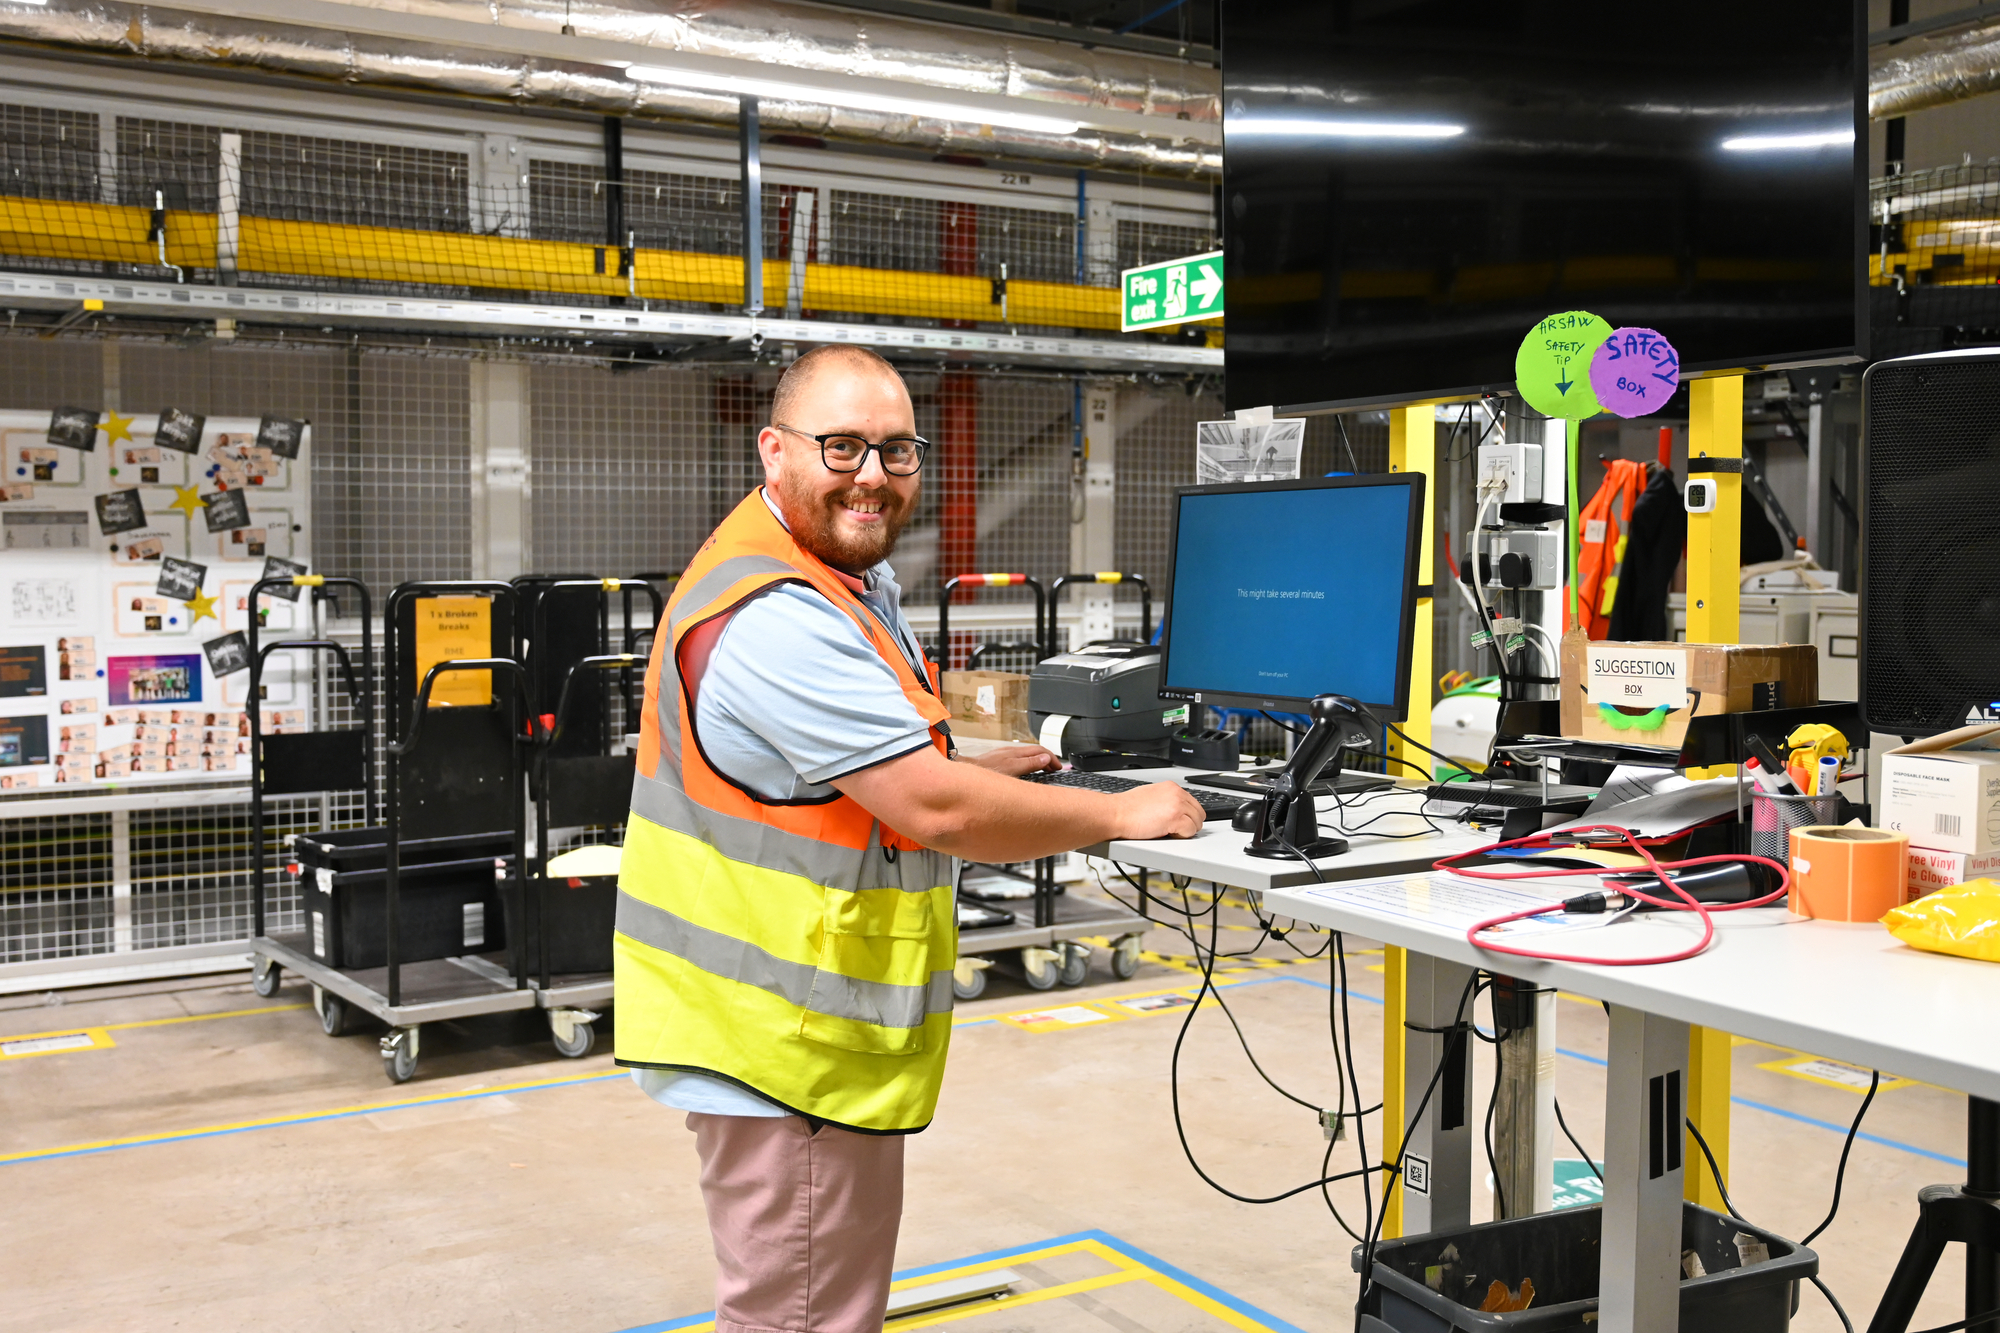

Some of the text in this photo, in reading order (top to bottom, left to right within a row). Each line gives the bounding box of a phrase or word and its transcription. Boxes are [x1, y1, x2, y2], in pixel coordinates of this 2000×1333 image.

[1130, 276, 1158, 298] Fire
[1130, 298, 1157, 322] exit
[1540, 315, 1595, 335] ARSAW
[1545, 340, 1586, 355] SAFETY
[1605, 332, 1678, 386] SAFETY
[1616, 376, 1646, 398] BOX
[1237, 588, 1325, 601] This might take several minutes
[1594, 658, 1675, 677] SUGGESTION
[1624, 684, 1643, 694] BOX
[1893, 771, 1921, 779] DISPOSABLE
[1908, 852, 1955, 871] ree Vinyl
[1971, 857, 1989, 870] Vinyl
[1920, 869, 1955, 886] Gloves
